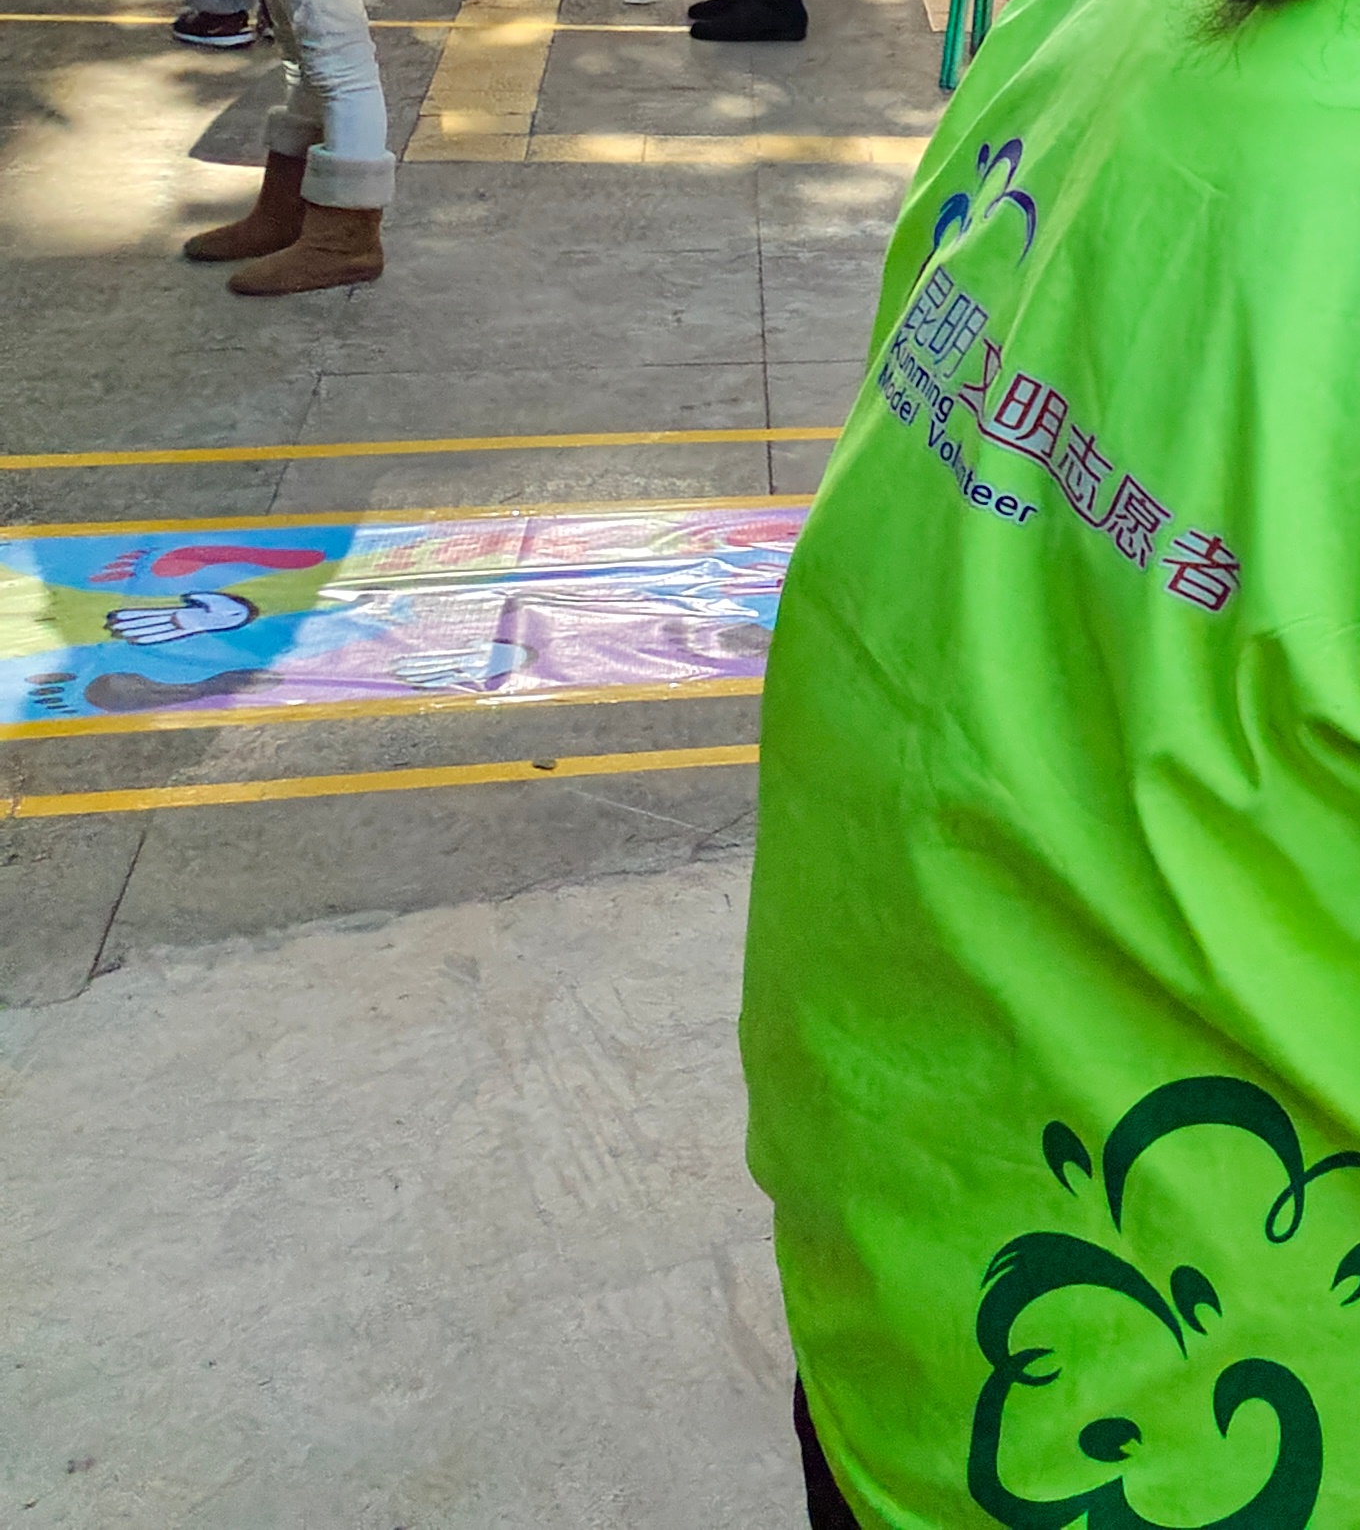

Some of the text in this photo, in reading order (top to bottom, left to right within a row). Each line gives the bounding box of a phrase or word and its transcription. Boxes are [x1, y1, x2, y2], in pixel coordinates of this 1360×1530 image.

[877, 362, 1038, 523] Model Volteer
[890, 330, 955, 424] Kunming
[903, 265, 1241, 612] 昆明文明志愿者
